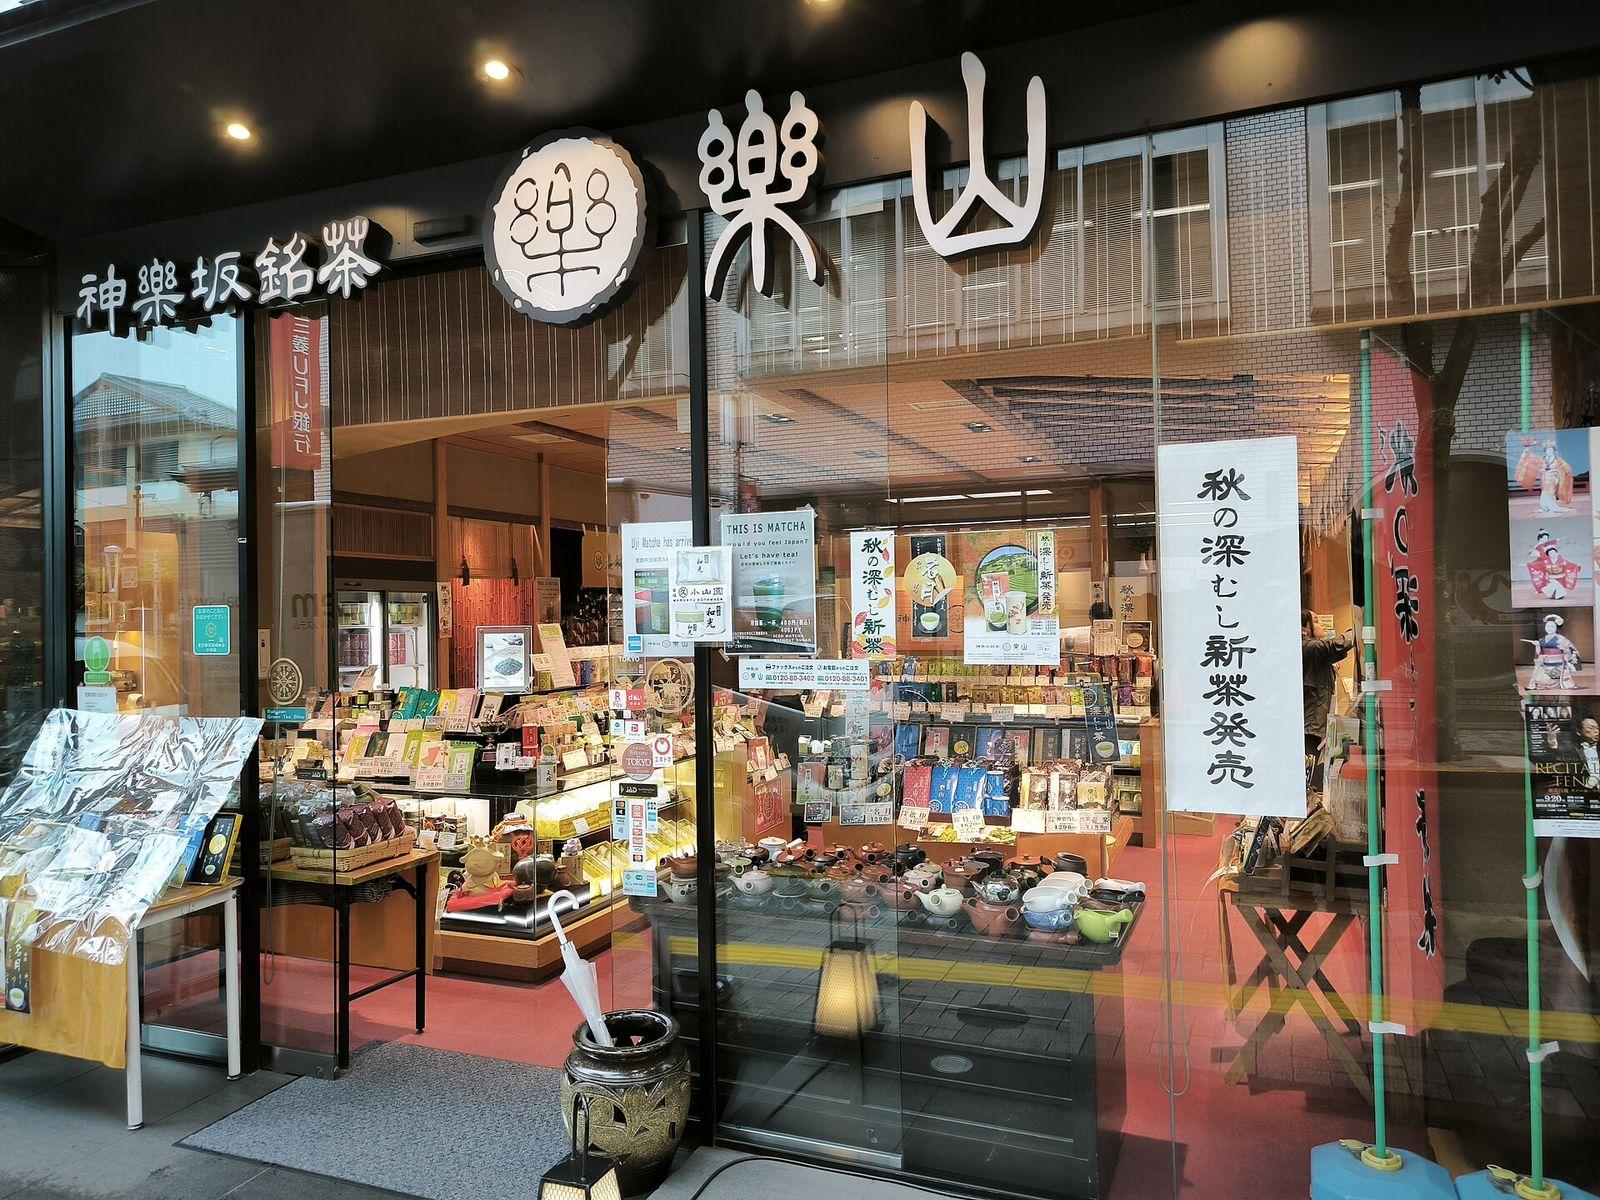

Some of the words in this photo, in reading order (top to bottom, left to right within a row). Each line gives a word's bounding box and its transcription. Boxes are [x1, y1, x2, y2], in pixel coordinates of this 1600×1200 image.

[726, 524, 749, 534] THIS
[753, 523, 763, 533] IS
[767, 521, 806, 532] MATCHA
[861, 537, 885, 654] 秋の深むし新茶
[1040, 535, 1053, 611] 秋の深むし新茶発売
[1197, 467, 1256, 789] 秋の深むし新茶発売
[626, 757, 652, 767] TOKYO
